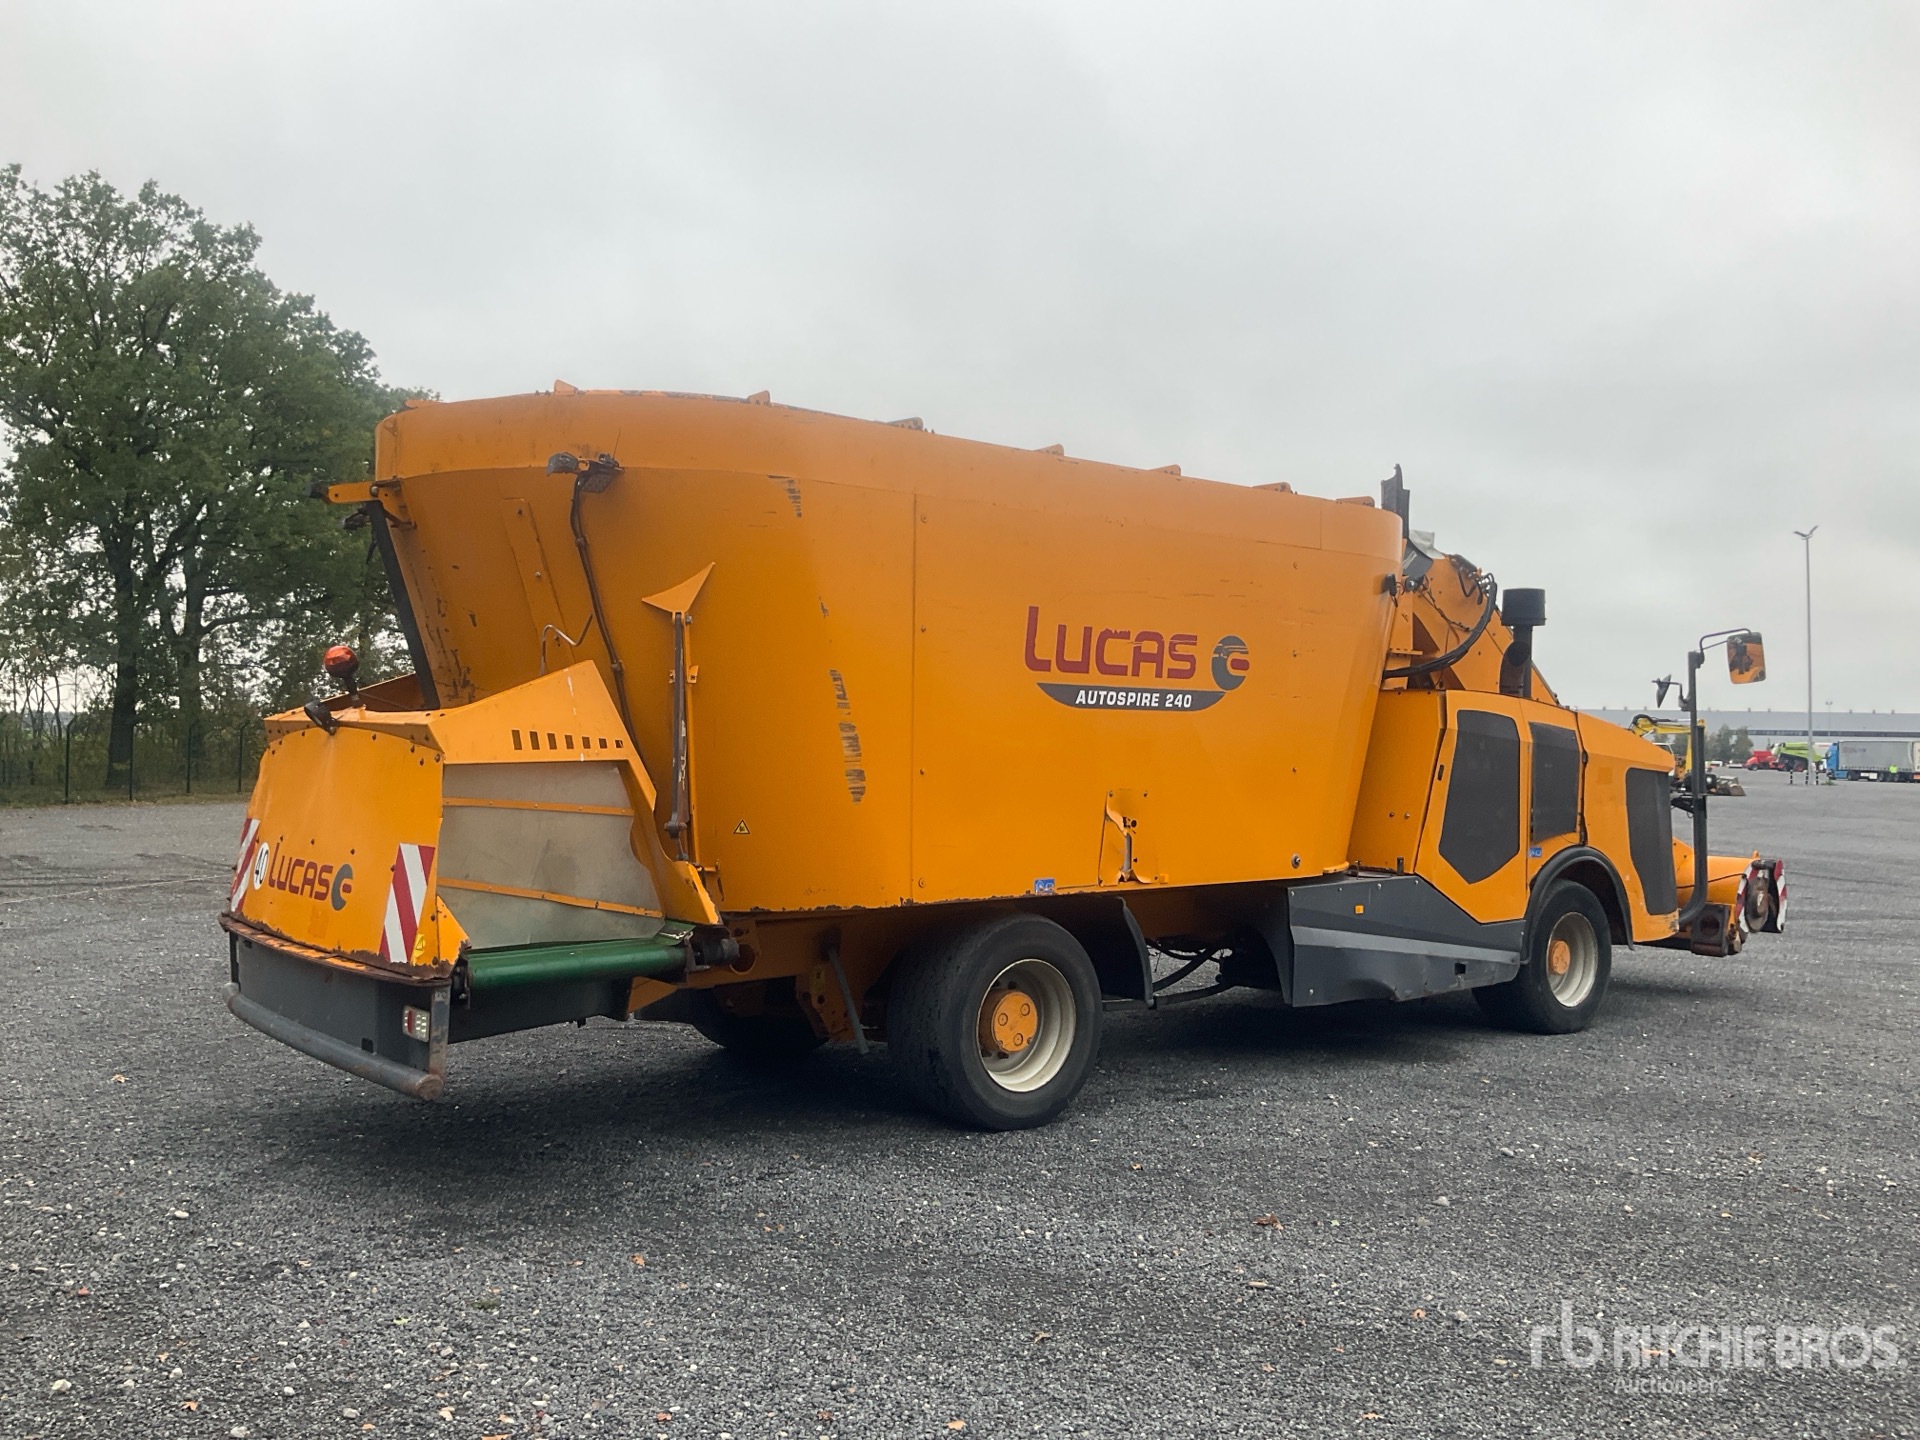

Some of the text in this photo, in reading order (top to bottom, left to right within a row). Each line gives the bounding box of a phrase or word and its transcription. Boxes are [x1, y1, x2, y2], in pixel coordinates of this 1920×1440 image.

[1025, 605, 1198, 680] LUCAS
[1075, 690, 1192, 708] AUTOSPIRE 240
[268, 843, 334, 901] LUCAS
